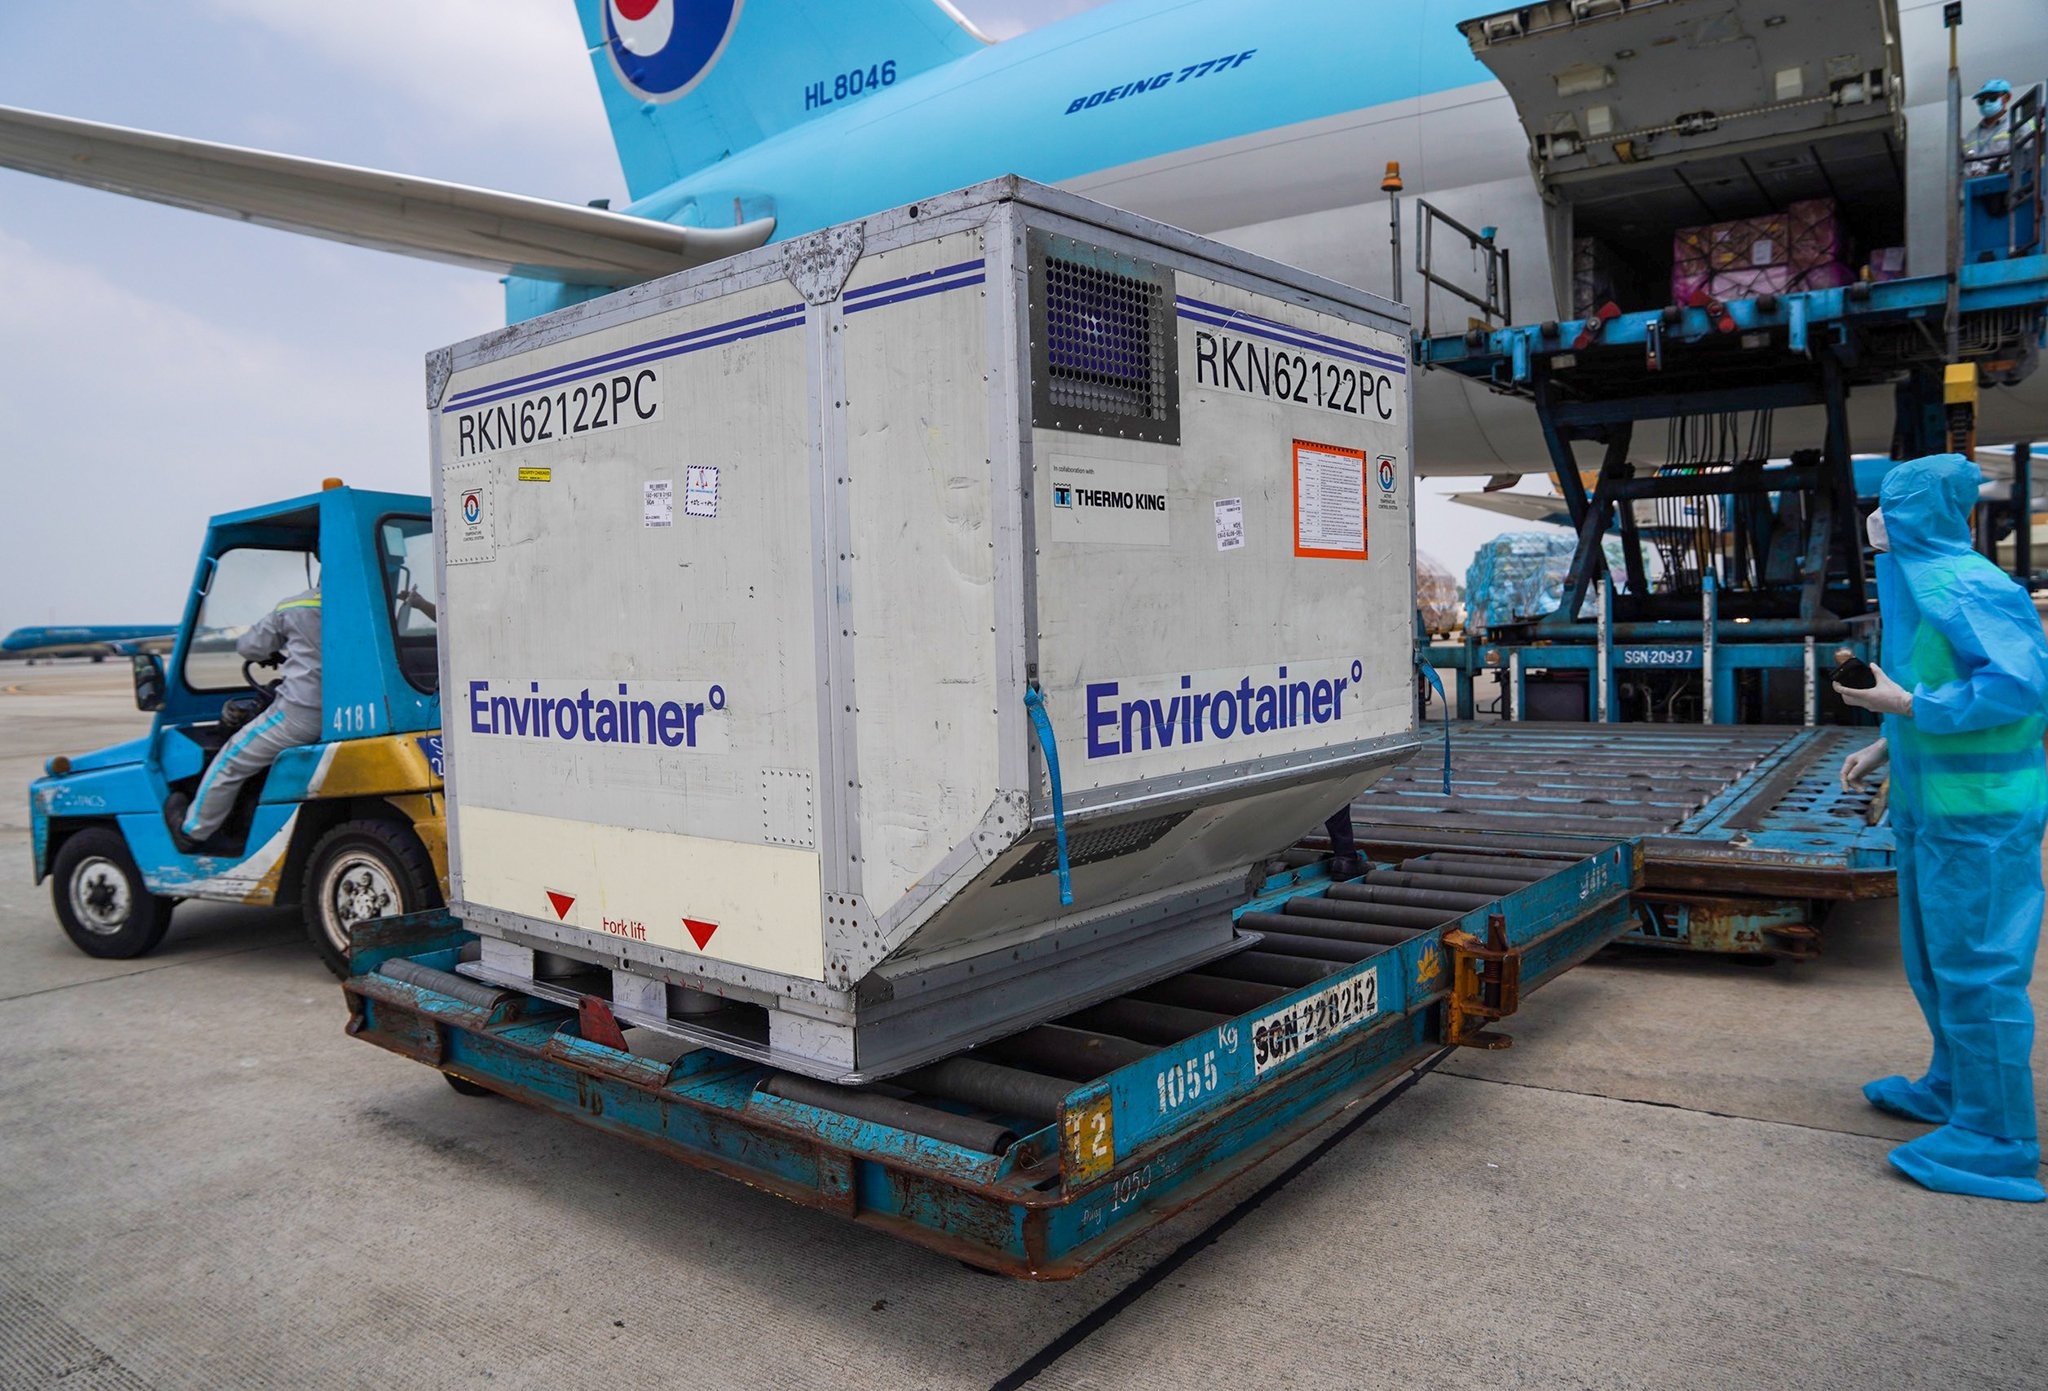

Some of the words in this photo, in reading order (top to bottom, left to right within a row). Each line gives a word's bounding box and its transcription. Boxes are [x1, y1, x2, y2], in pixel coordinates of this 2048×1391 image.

[805, 60, 896, 111] HL8046
[1064, 72, 1174, 115] BOEING
[1176, 49, 1258, 83] 777F
[1197, 331, 1392, 420] RKN62122PC
[459, 370, 657, 457] RKN62122PC
[1059, 465, 1085, 474] collaboration
[1075, 489, 1133, 509] THERMO
[1136, 493, 1166, 511] KING
[1624, 650, 1693, 664] SGN-20937
[333, 702, 375, 732] 4181
[603, 916, 629, 937] Fork
[630, 920, 646, 941] lift
[1156, 1050, 1218, 1114] 1055
[1218, 1023, 1239, 1054] Kg
[1111, 1164, 1152, 1213] 1050
